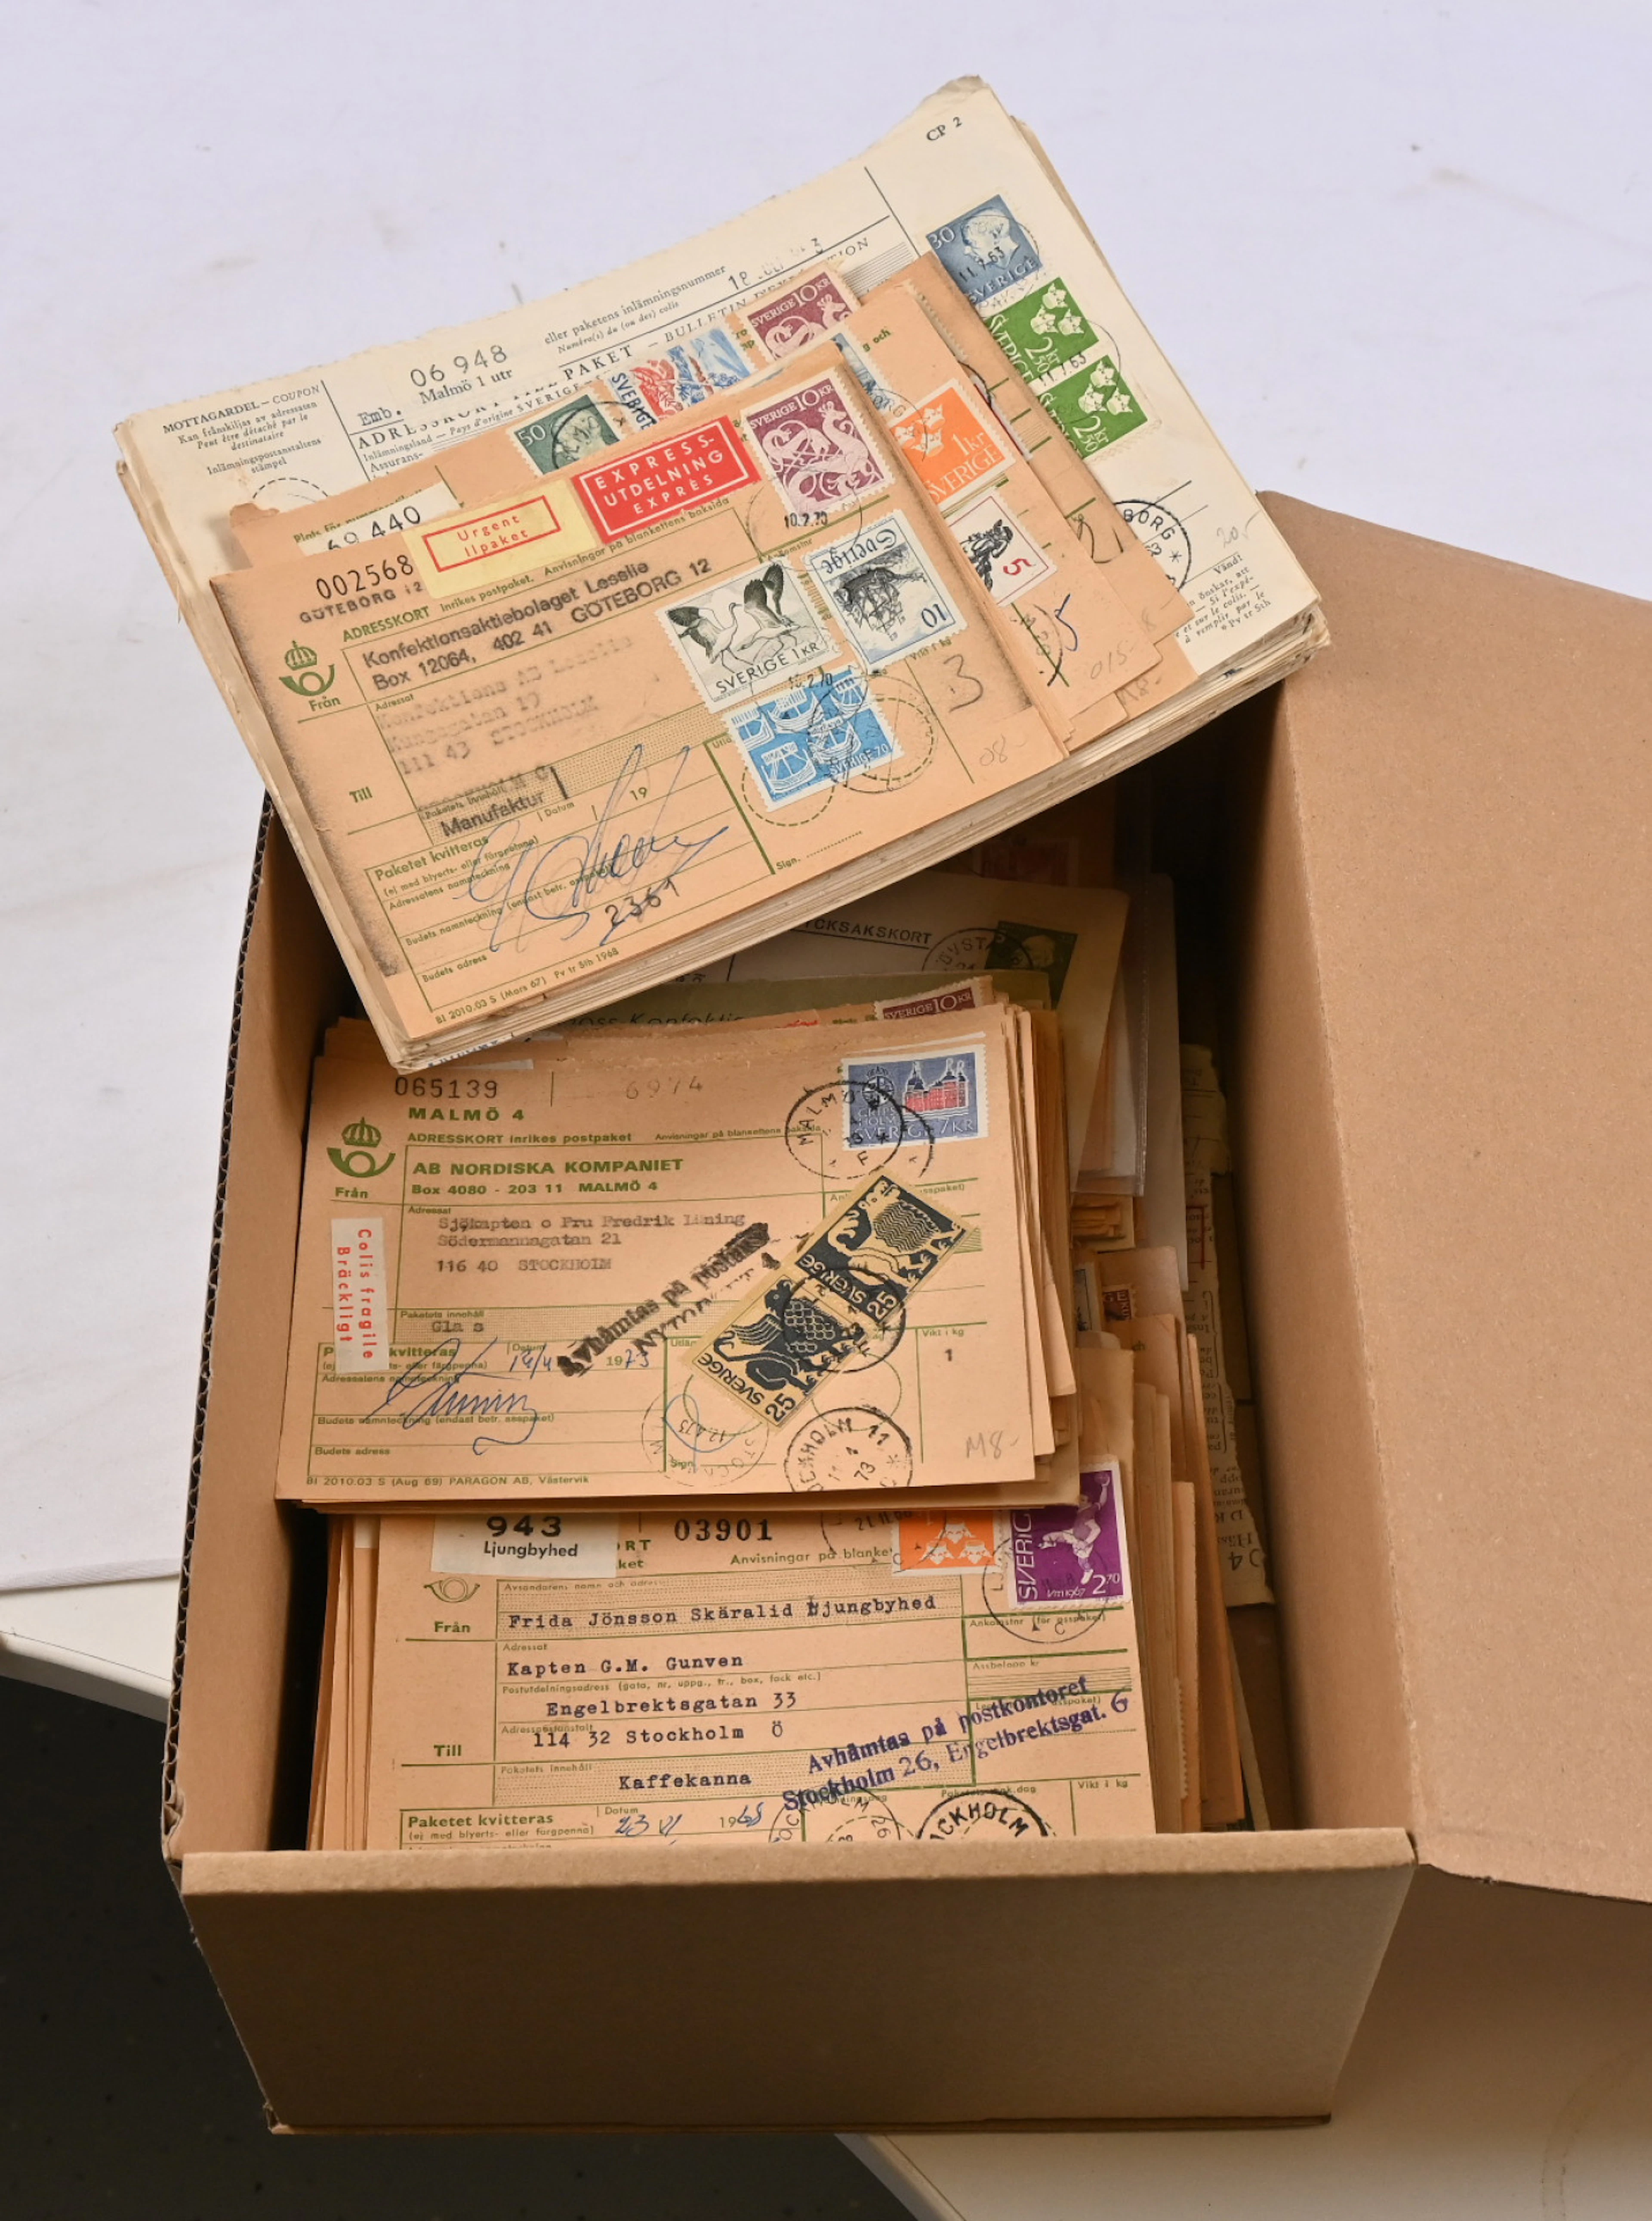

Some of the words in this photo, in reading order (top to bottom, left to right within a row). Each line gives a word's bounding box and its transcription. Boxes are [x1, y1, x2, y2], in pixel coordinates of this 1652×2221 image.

[926, 125, 947, 141] CP
[953, 117, 962, 127] 2
[929, 226, 955, 249] 30
[545, 332, 568, 345] eller
[572, 311, 620, 336] paketens
[622, 265, 726, 315] inlämningsnummer
[752, 299, 796, 327] SVERIGE
[792, 285, 817, 306] 10
[564, 344, 632, 380] PAKET
[272, 385, 320, 404] COUPON
[419, 380, 472, 404] Malmö
[358, 407, 401, 426] Emb.
[475, 410, 513, 427] d'origine
[750, 401, 795, 429] SVERIGE
[795, 389, 820, 412] 10
[178, 434, 199, 444] Kan
[271, 401, 317, 419] adressaten
[231, 431, 284, 451] destinataire
[518, 425, 546, 447] 50
[251, 457, 287, 474] stämpel
[595, 434, 714, 490] EXPRESS-
[604, 450, 723, 506] UTDELNING
[929, 447, 1002, 502] SVERIGE
[633, 474, 713, 515] EXPRÈS
[371, 506, 420, 538] 440
[457, 515, 520, 542] Urgent
[316, 555, 413, 599] 002568
[343, 607, 429, 642] ADRESSKORT
[544, 547, 605, 576] Anvisningar
[625, 515, 686, 545] blankettens
[688, 498, 730, 517] baksida
[1003, 558, 1035, 575] 5
[300, 589, 396, 623] GÖTEBORG
[362, 587, 579, 668] Konfektionsaktiebolaget
[373, 671, 411, 690] Box
[419, 648, 477, 676] 12064,
[492, 630, 525, 651] 402
[532, 621, 552, 637] 41
[571, 570, 682, 623] GÖTEBORG
[689, 558, 712, 576] 12
[716, 652, 789, 693] SVERIGE
[802, 642, 820, 653] KR
[309, 696, 341, 712] Från
[375, 694, 414, 711] Adressat
[349, 787, 373, 804] Till
[545, 801, 574, 817] Datum
[630, 787, 647, 800] 19
[440, 792, 544, 837] Manufaktur
[375, 856, 427, 881] Paketet
[430, 836, 488, 863] kvitteras
[776, 858, 801, 870] Sign.
[401, 879, 420, 891] med
[389, 887, 444, 911] Adressatens
[405, 931, 437, 946] Budets
[440, 909, 503, 934] namnteckning
[422, 965, 453, 983] Budets
[457, 955, 487, 970] adress
[450, 998, 487, 1020] 2010.03
[596, 948, 620, 962] 1968
[932, 995, 956, 1013] 10
[395, 1077, 498, 1098] 065139
[409, 1107, 499, 1121] MALMÖ
[512, 1109, 524, 1120] 4
[952, 1119, 973, 1132] KR
[407, 1134, 504, 1144] ADRESSKORT
[510, 1134, 556, 1143] inrikes
[563, 1133, 631, 1145] postpaket
[655, 1132, 708, 1140] Anvisningar
[413, 1162, 441, 1175] AB
[451, 1162, 555, 1175] NORDISKA
[565, 1159, 683, 1173] KOMPANIET
[336, 1187, 368, 1198] Från
[412, 1184, 441, 1195] Box
[448, 1185, 487, 1195] 4080
[509, 1185, 536, 1194] 203
[546, 1184, 562, 1193] 11
[579, 1180, 640, 1192] MALMÖ
[648, 1182, 657, 1190] 4
[408, 1206, 451, 1214] Adressat
[562, 1217, 593, 1228] Fru
[602, 1214, 675, 1227] Fredrik
[601, 1232, 622, 1244] 21
[358, 1229, 373, 1278] Colis
[437, 1260, 467, 1272] 116
[477, 1260, 498, 1272] 40
[518, 1258, 611, 1270] STOCKHOLM
[337, 1247, 353, 1342] Bräckligt
[867, 1291, 897, 1319] 25
[359, 1288, 376, 1358] fragile
[447, 1310, 484, 1318] innehåll
[922, 1328, 942, 1337] Vikt
[952, 1328, 964, 1337] kg
[697, 1352, 764, 1406] SVERIGE
[765, 1393, 796, 1421] 25
[436, 1416, 474, 1425] (endast
[323, 1478, 372, 1486] 2010.03
[392, 1477, 418, 1487] (Aug
[513, 1477, 532, 1485] AB,
[539, 1476, 589, 1484] Västervik
[487, 1515, 561, 1537] 943
[674, 1519, 773, 1541] 03901
[484, 1541, 579, 1559] Ljungbyhed
[730, 1553, 809, 1565] Anvisningar
[1092, 1575, 1106, 1594] 2
[435, 1621, 471, 1633] Från
[509, 1615, 573, 1629] Frida
[588, 1611, 677, 1626] Jönsson
[691, 1604, 793, 1621] Skäralid
[507, 1661, 586, 1678] Kapten
[601, 1659, 649, 1673] G.M.
[666, 1656, 743, 1670] Gunven
[502, 1683, 610, 1694] Postutdelningsadress
[770, 1674, 791, 1682] fack
[546, 1696, 757, 1718] Engelbrektsgatan
[773, 1692, 796, 1709] 33
[809, 1732, 910, 1773] Avhämtas
[922, 1717, 946, 1742] på
[959, 1674, 1089, 1733] postkontoret
[534, 1733, 570, 1749] 114
[589, 1731, 610, 1747] 32
[626, 1726, 744, 1743] Stockholm
[773, 1721, 783, 1737] Ö
[434, 1745, 462, 1757] Till
[783, 1766, 895, 1810] Stockholm
[900, 1750, 940, 1777] 26,
[946, 1704, 1106, 1762] Engelbrektsgat.
[1111, 1691, 1128, 1713] 6
[619, 1773, 751, 1790] Kaffekanna
[1116, 1780, 1128, 1788] kg
[408, 1815, 472, 1828] Paketet
[478, 1813, 553, 1826] kvitteras
[721, 1817, 736, 1828] 19
